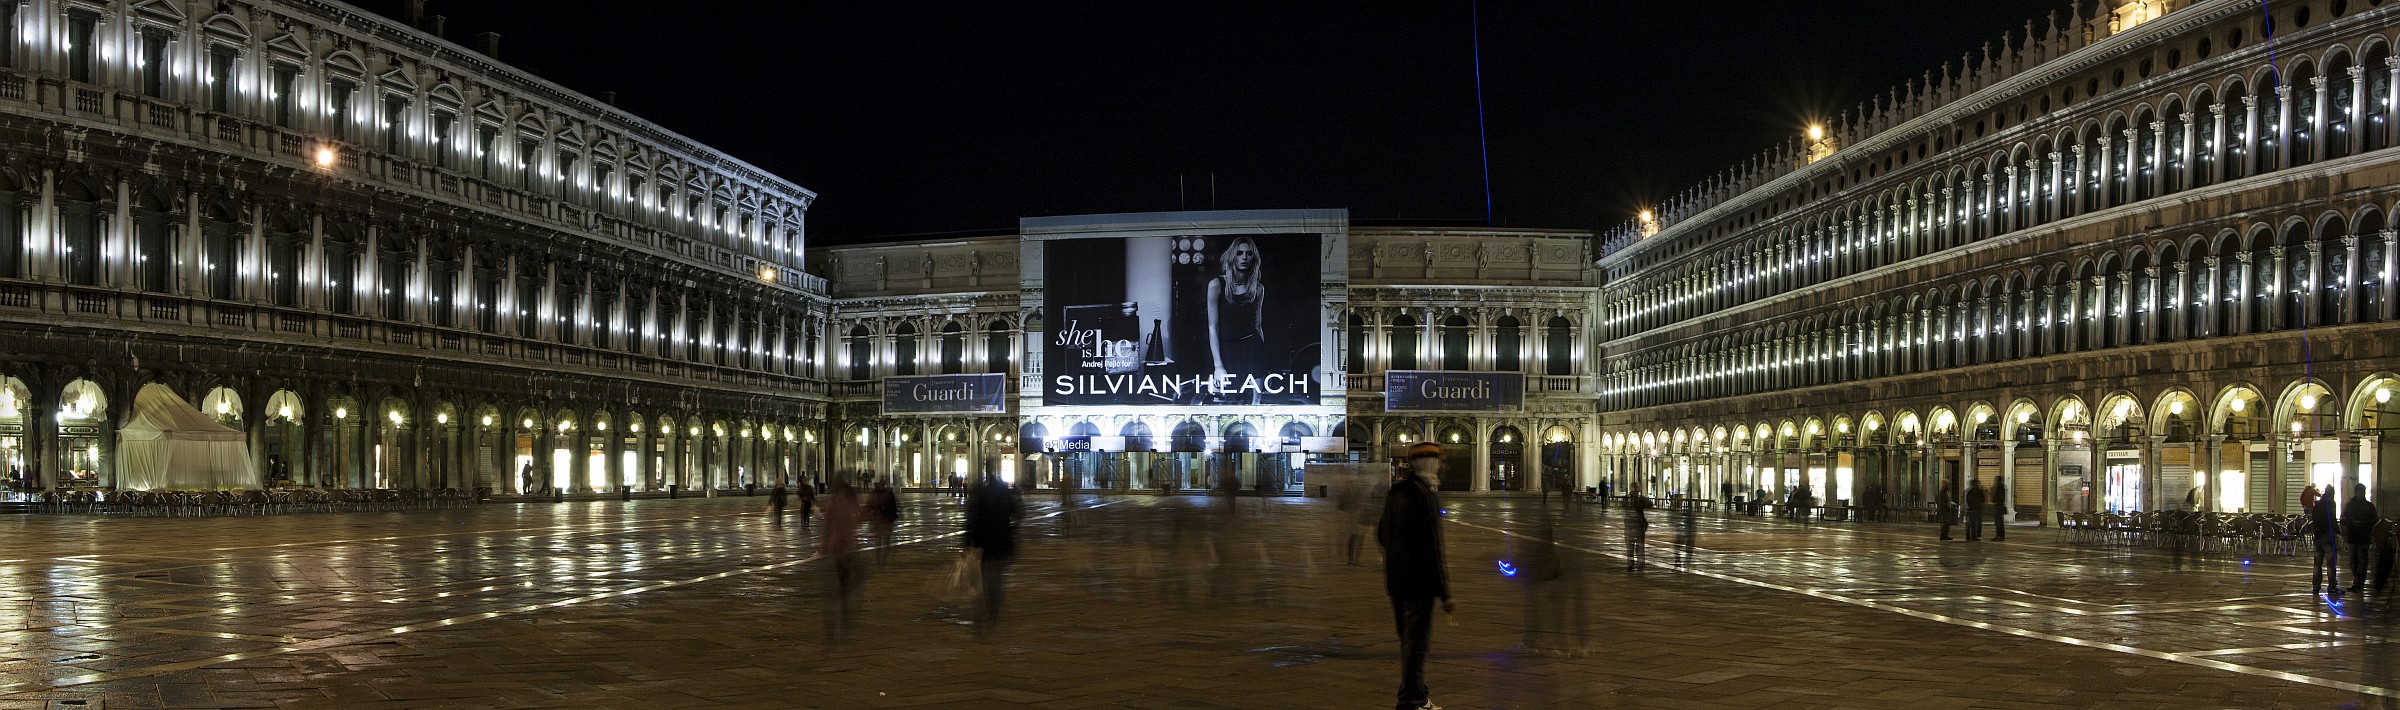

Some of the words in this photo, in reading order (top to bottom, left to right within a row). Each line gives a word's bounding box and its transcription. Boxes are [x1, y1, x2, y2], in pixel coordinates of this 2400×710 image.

[1056, 320, 1094, 347] she
[1094, 329, 1132, 358] he
[1082, 345, 1092, 358] is
[913, 382, 974, 401] Guardi
[1055, 374, 1180, 395] SILVIAN
[1195, 374, 1308, 394] HEACH
[1421, 379, 1490, 399] Guardi
[1060, 439, 1090, 450] Media
